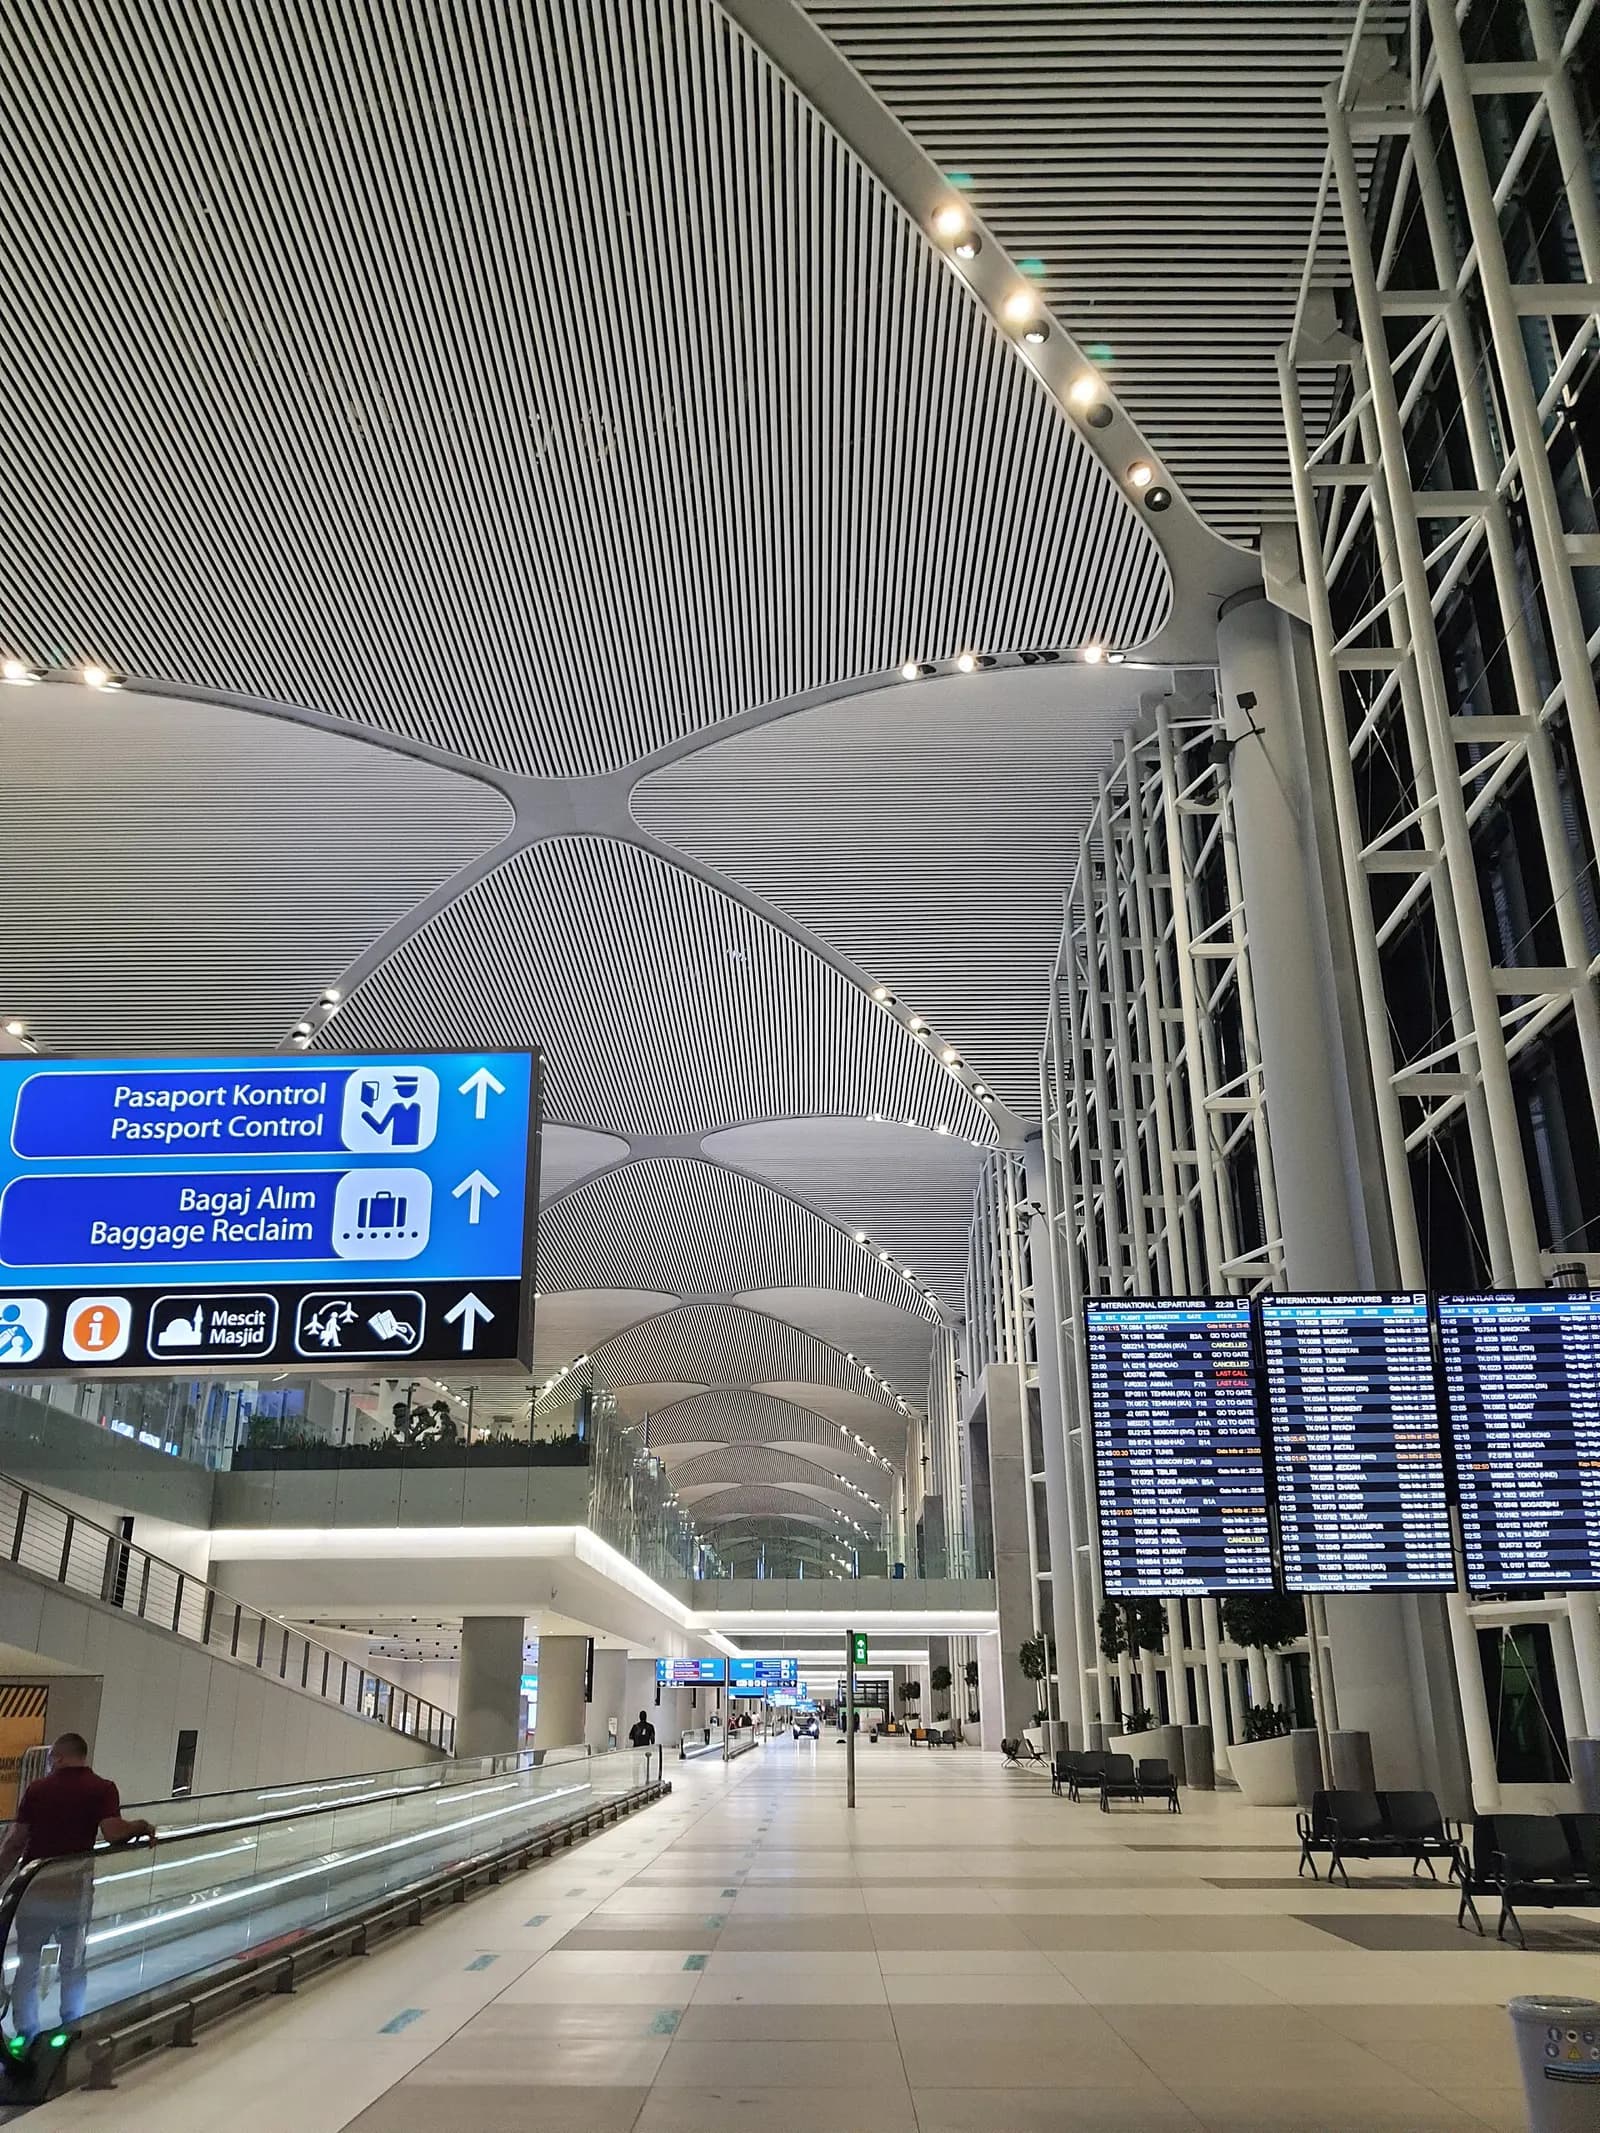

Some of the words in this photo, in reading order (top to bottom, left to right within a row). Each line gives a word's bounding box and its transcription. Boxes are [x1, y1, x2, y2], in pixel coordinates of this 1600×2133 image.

[115, 1087, 226, 1111] Pasaport
[234, 1083, 326, 1105] Kontrol
[112, 1118, 222, 1143] Passport
[229, 1114, 323, 1136] Control
[180, 1188, 250, 1216] Bagaj
[257, 1186, 315, 1209] Alım
[91, 1222, 204, 1249] Baggage
[213, 1217, 312, 1241] Reclaim
[1101, 1301, 1156, 1309] INTERNATIONAL
[1275, 1296, 1332, 1304] INTERNATIONAL
[1333, 1295, 1382, 1303] DEPARTURES
[212, 1310, 266, 1325] Mescit
[210, 1327, 264, 1347] Masjid
[1226, 1535, 1264, 1544] CANCELLED
